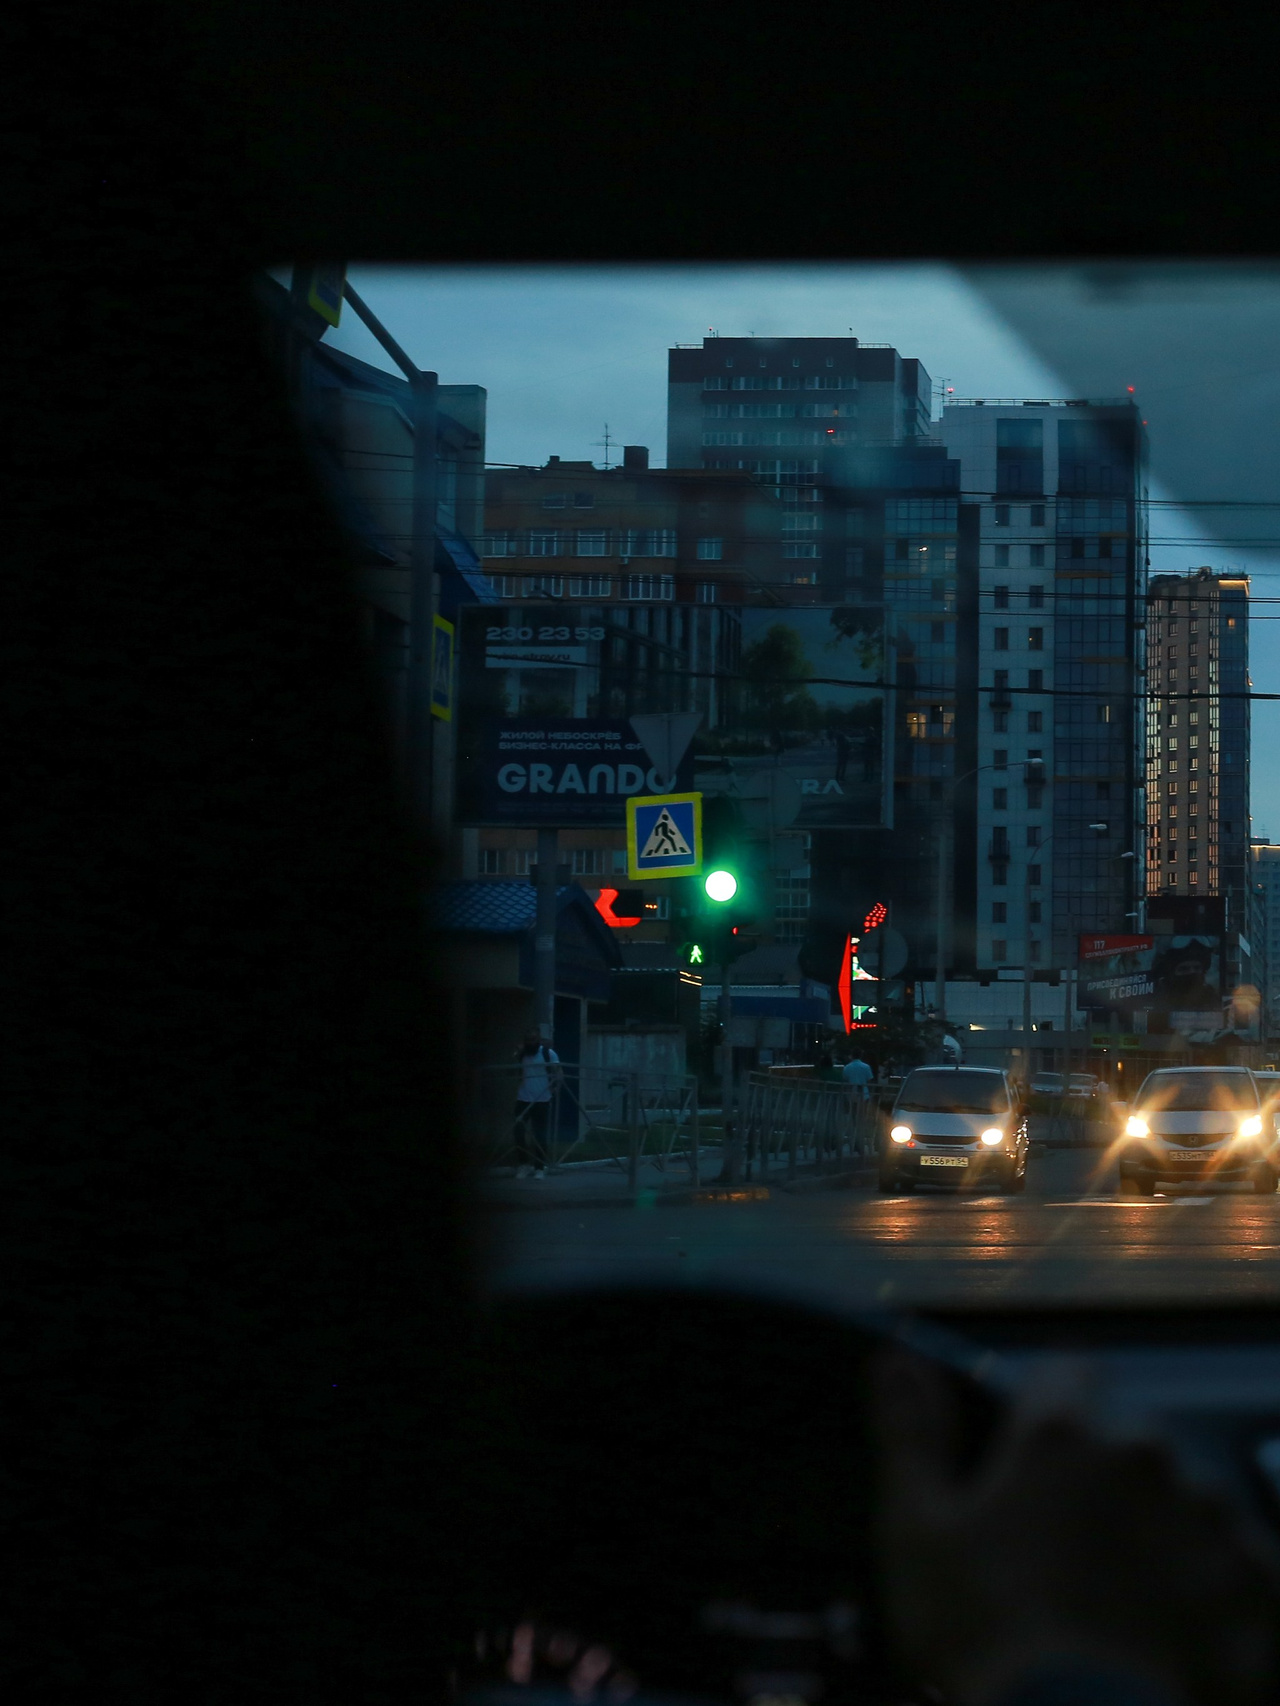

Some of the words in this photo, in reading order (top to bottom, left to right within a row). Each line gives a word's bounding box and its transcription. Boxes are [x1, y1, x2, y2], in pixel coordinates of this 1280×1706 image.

[486, 626, 534, 641] 230
[538, 626, 571, 641] 23
[574, 626, 606, 641] 53
[499, 730, 545, 740] ЖИЛОЙ
[548, 730, 622, 740] НЕБОСКРЁБ
[498, 741, 600, 751] БИЗНЕС-КЛАССА
[604, 742, 622, 751] НА
[1087, 974, 1147, 991] ПРИСОЕДИНЯЙСЯ
[1109, 988, 1117, 1000] К
[1119, 982, 1154, 999] СВОИМ
